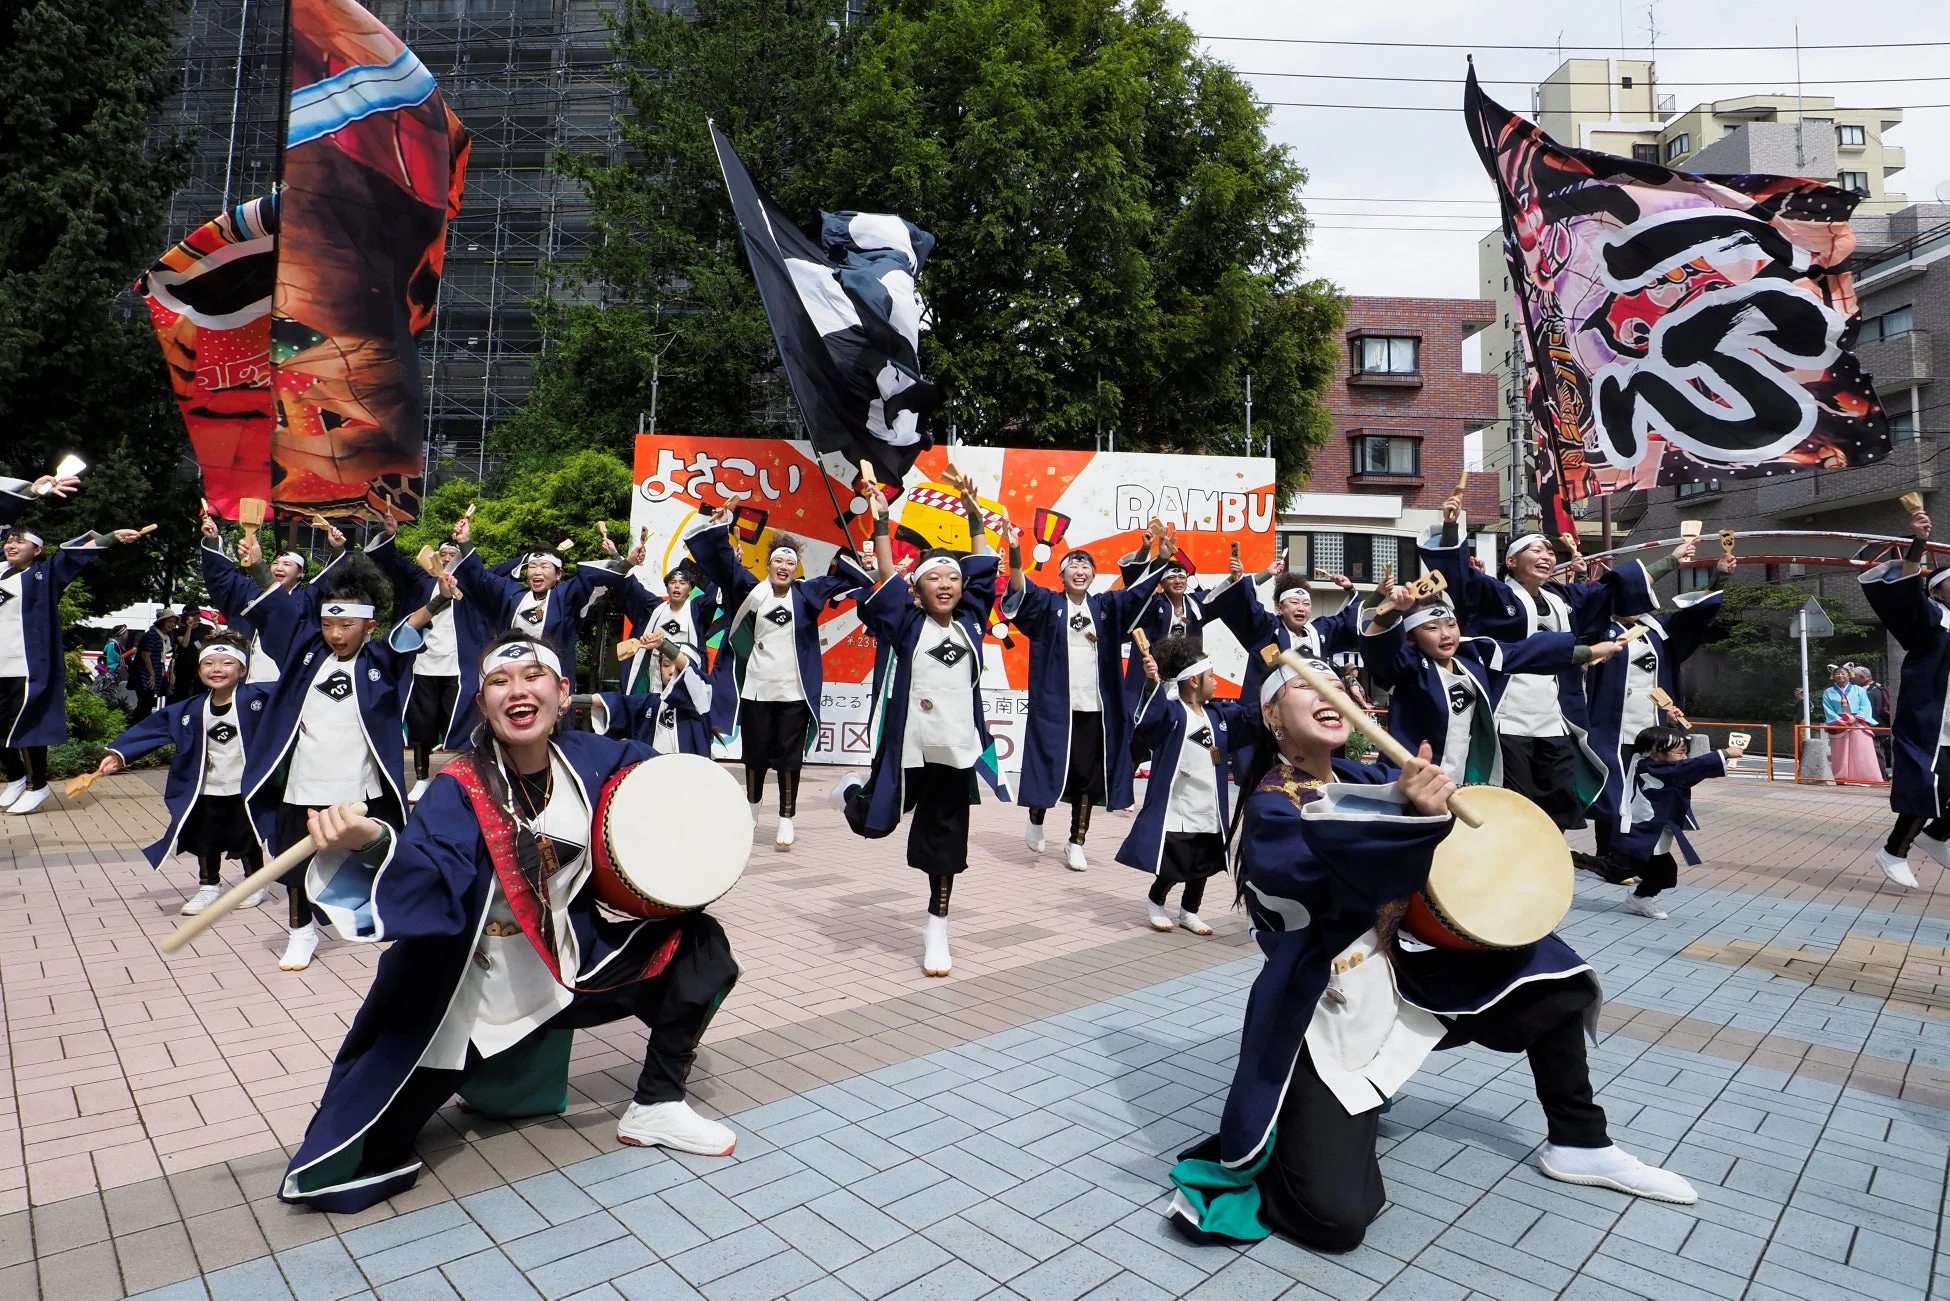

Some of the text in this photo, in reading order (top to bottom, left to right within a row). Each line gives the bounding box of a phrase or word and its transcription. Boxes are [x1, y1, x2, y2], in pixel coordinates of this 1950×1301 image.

[640, 448, 802, 502] よさこい
[820, 694, 872, 708] おこる
